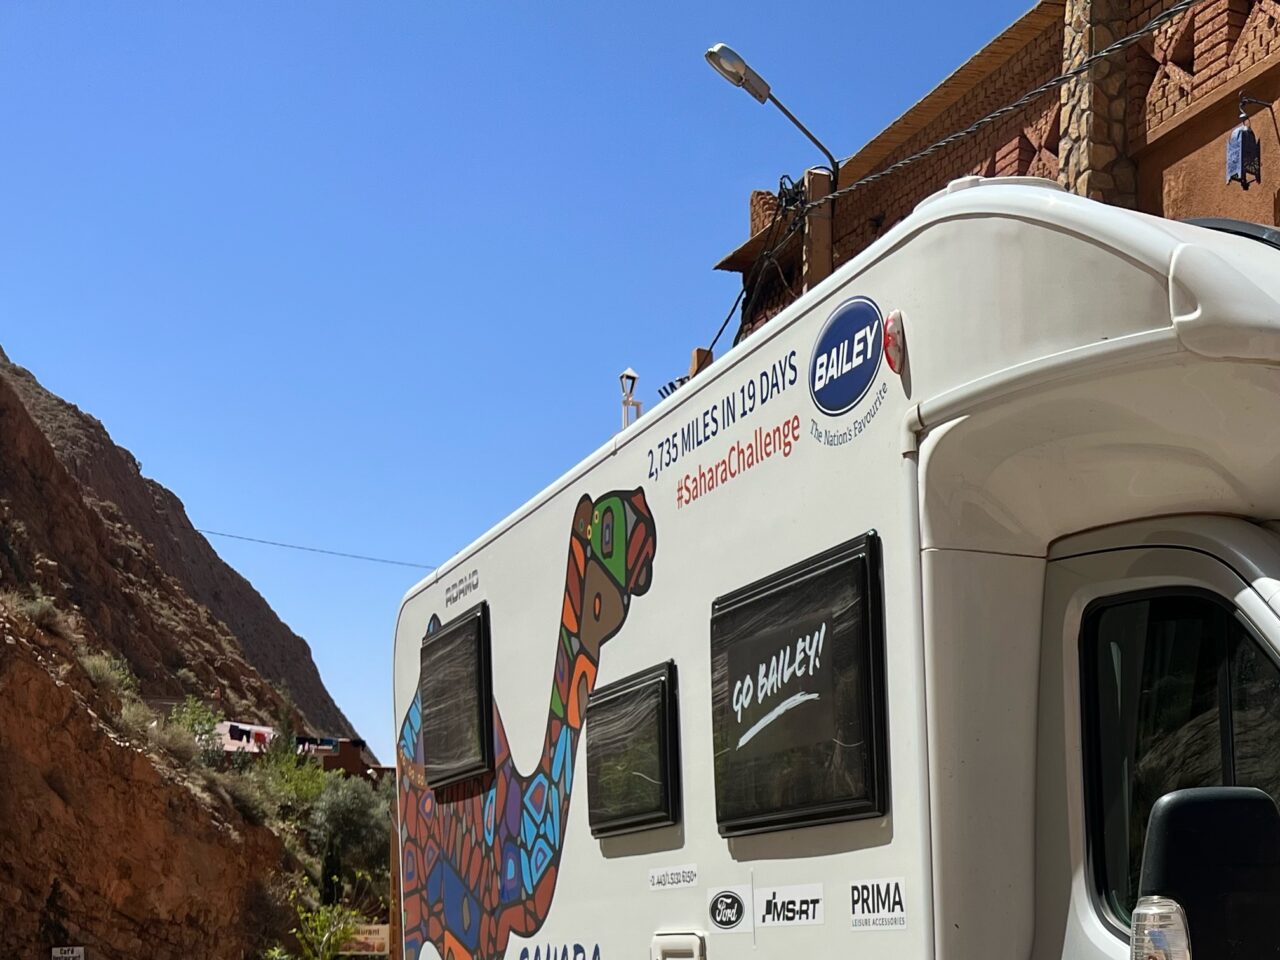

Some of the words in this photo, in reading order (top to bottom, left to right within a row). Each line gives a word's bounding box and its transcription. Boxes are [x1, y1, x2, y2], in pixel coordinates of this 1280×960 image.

[814, 319, 879, 392] BAILEY
[648, 432, 678, 481] 2,735
[681, 405, 718, 456] MILES
[722, 391, 736, 430] IN
[740, 378, 756, 418] 19
[760, 350, 798, 405] DAYS
[810, 418, 823, 443] The
[823, 427, 853, 446] Nation's
[853, 381, 888, 438] Favourite
[676, 414, 800, 509] #SaharaChallenge
[733, 674, 754, 722] GO
[758, 622, 826, 704] BAILEY!
[715, 896, 738, 923] Ford
[851, 882, 904, 914] PRIMA
[852, 918, 870, 927] LEISURE
[872, 917, 905, 926] ACCESSORIES
